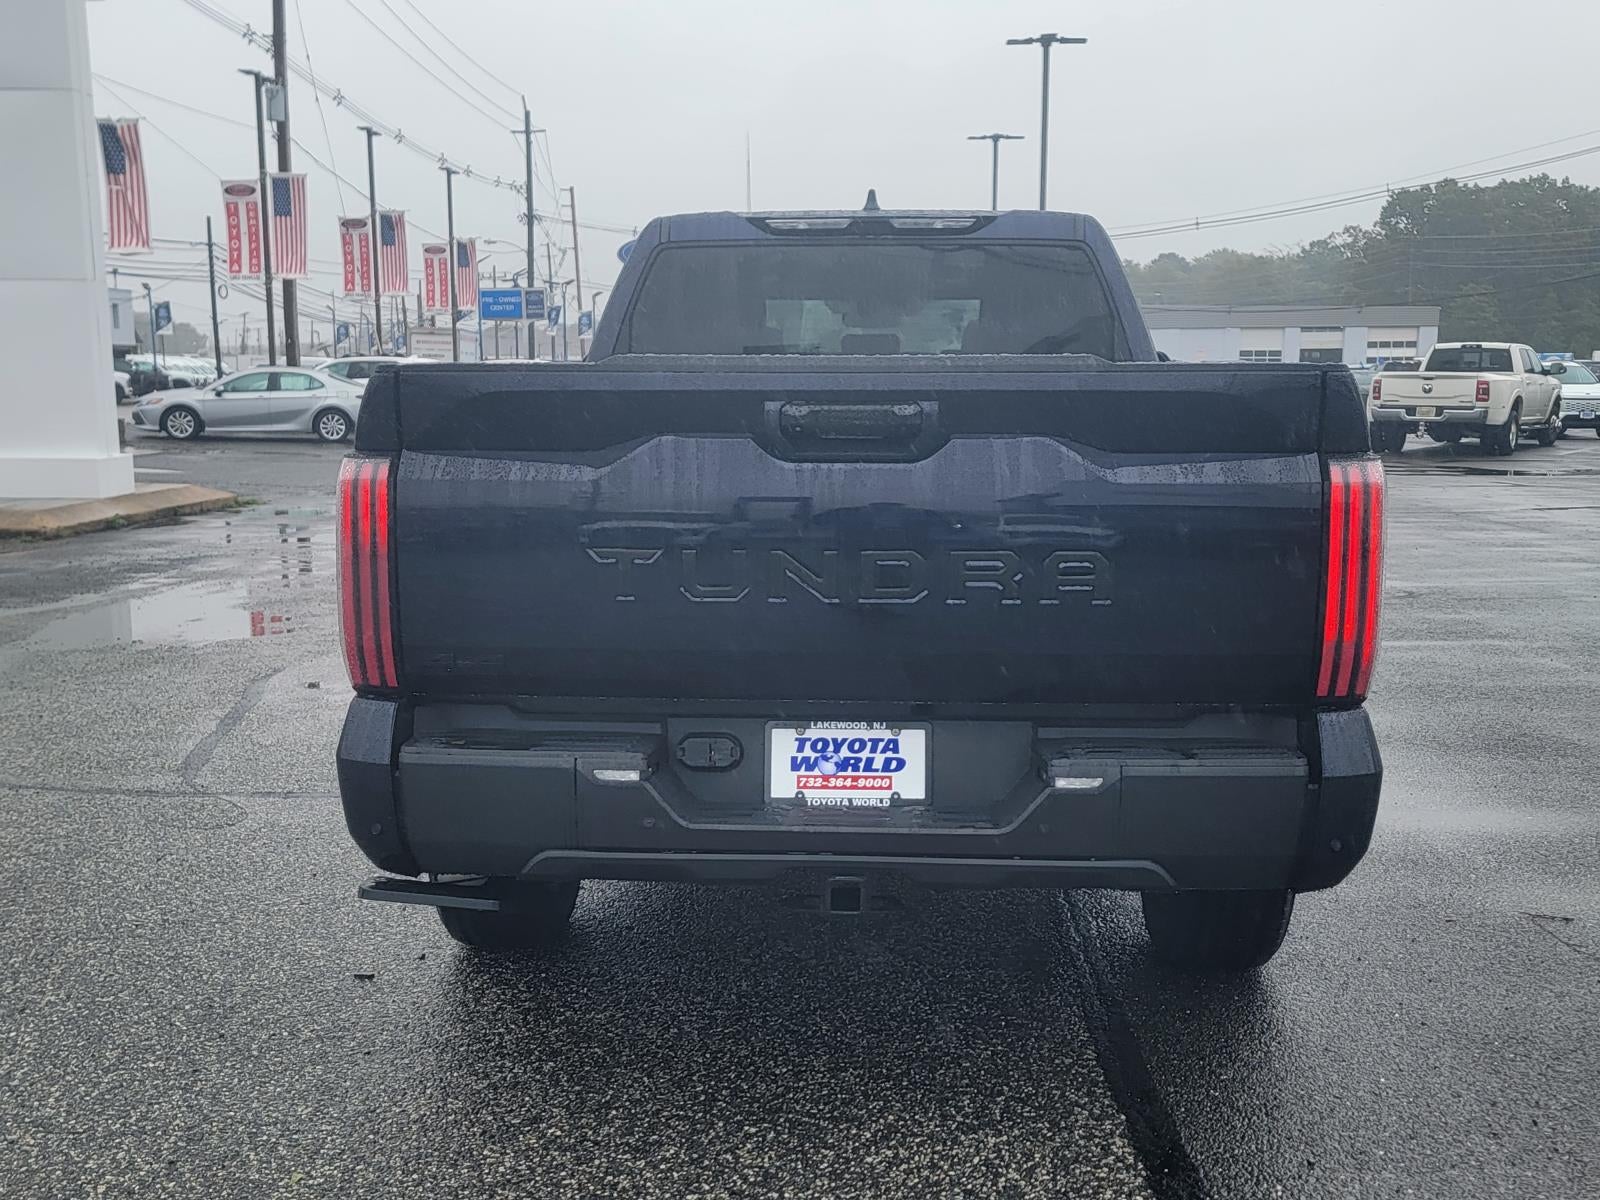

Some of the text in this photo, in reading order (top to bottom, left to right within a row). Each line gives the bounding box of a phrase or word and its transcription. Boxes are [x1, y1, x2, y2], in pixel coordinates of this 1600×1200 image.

[228, 203, 240, 272] TOYOTA
[345, 234, 354, 290] TOYOTA
[585, 548, 1113, 605] TUNDRA
[810, 721, 870, 730] LAKEWOOD,
[794, 737, 900, 754] TOYOTA
[799, 777, 891, 787] 732-364-9000
[806, 798, 891, 807] TOYOTA WORLD
